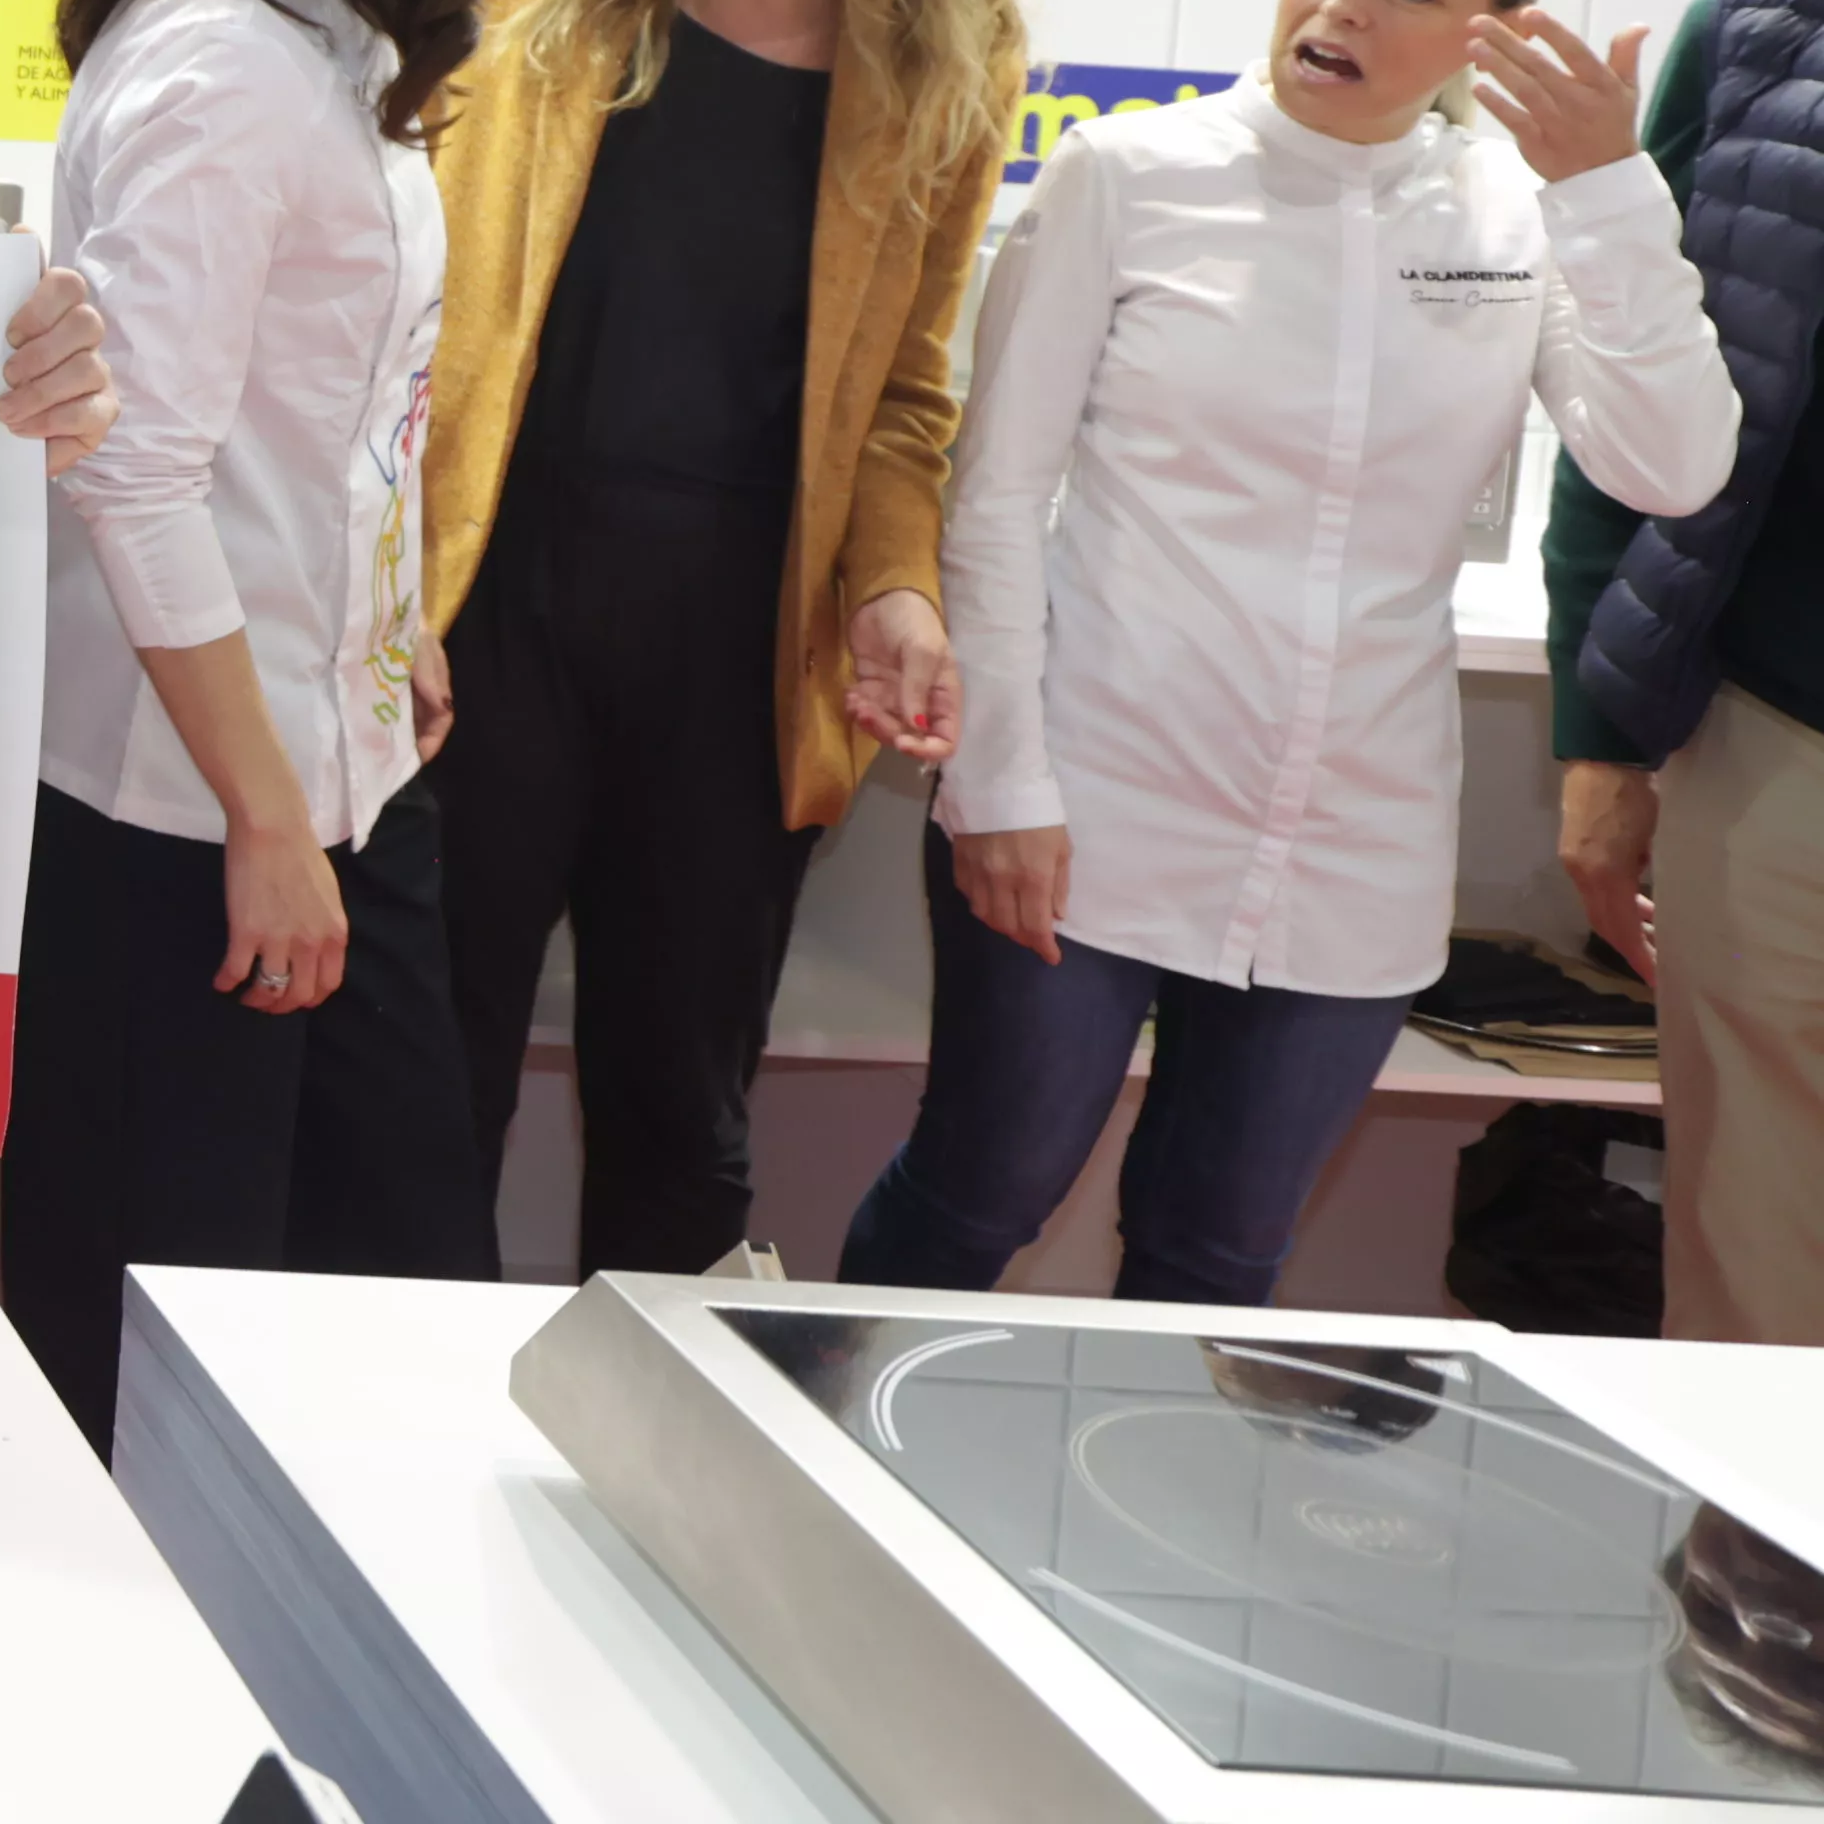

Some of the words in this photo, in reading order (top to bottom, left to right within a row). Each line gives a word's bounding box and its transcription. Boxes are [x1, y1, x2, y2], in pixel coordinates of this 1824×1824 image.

[17, 66, 40, 80] DE
[1399, 268, 1419, 280] LA
[1424, 271, 1533, 281] CLANDESTINA
